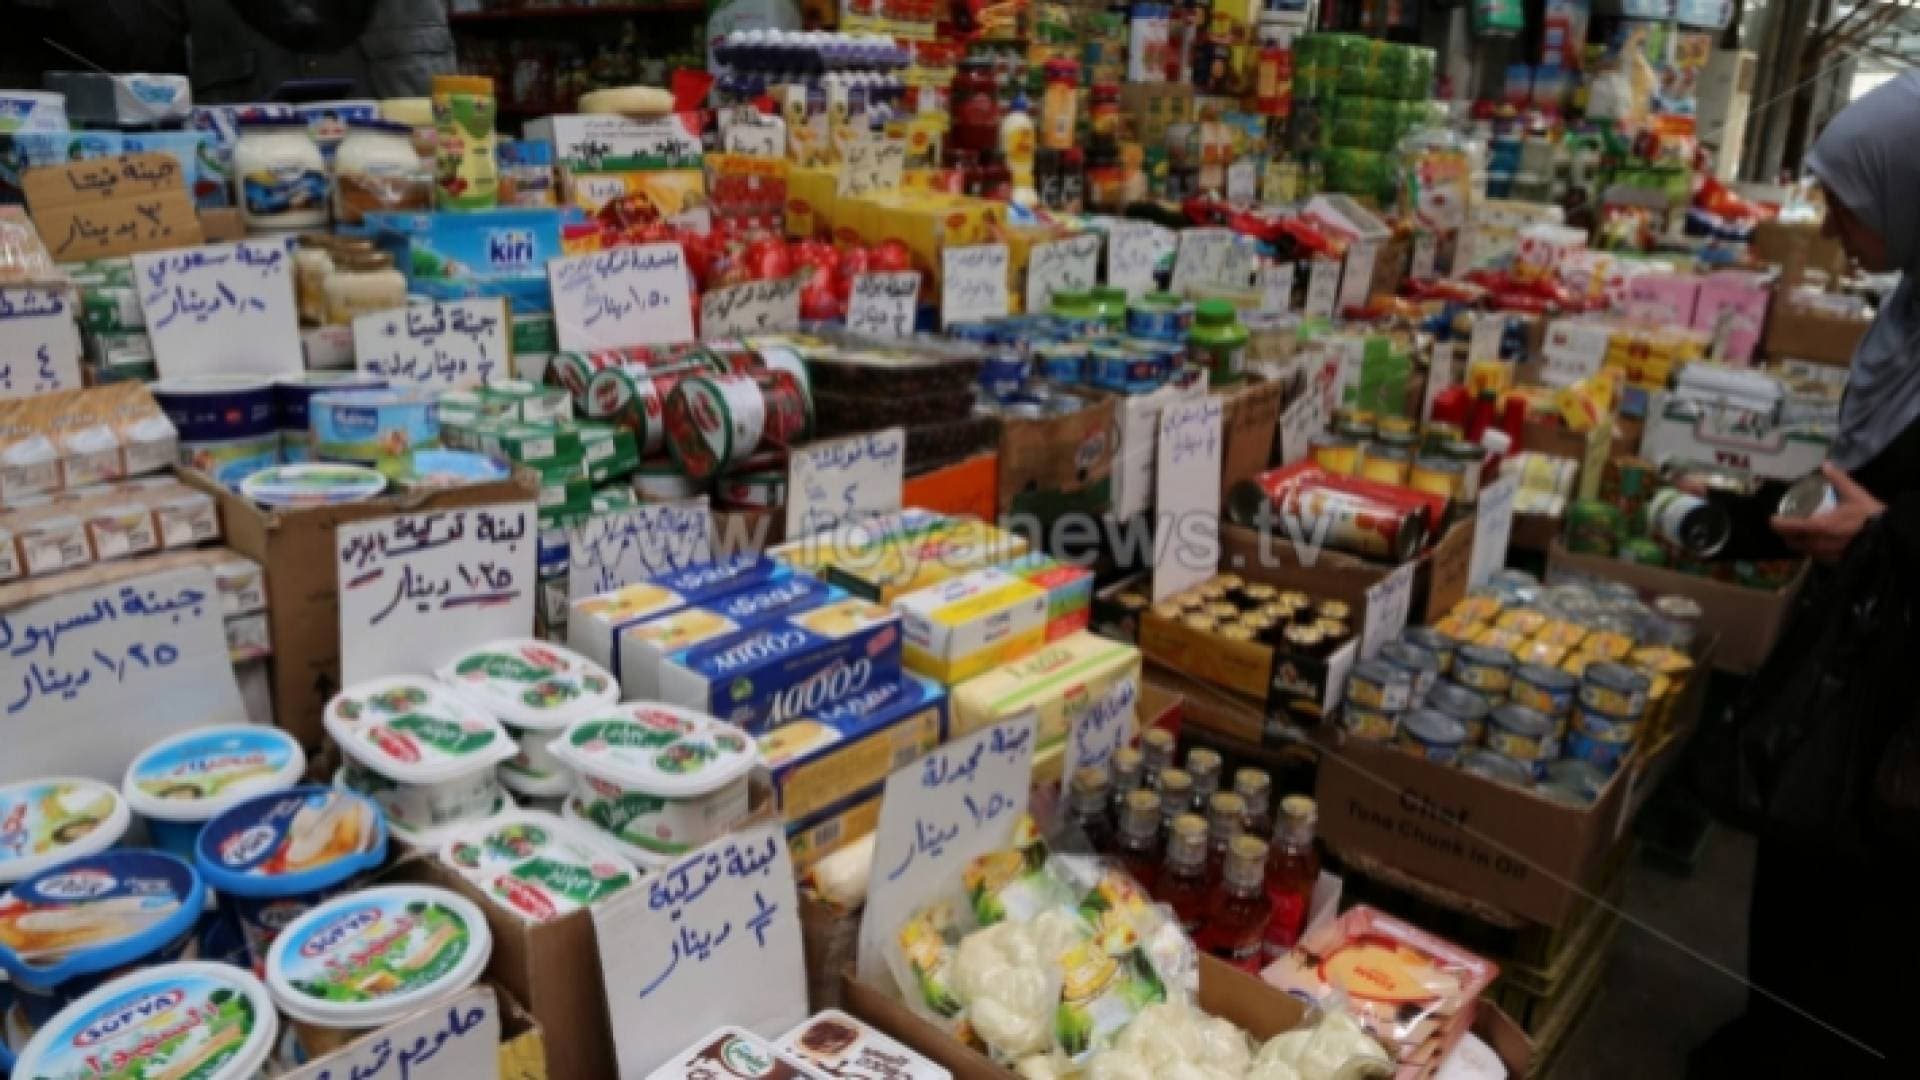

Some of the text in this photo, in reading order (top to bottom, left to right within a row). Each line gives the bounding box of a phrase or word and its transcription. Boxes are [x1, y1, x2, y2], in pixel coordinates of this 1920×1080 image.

[490, 234, 533, 264] kiri
[118, 585, 206, 626] جبنة
[369, 563, 452, 626] دينار
[7, 662, 92, 715] دينار
[1348, 799, 1395, 830] Tuna
[1400, 818, 1464, 856] Chunk
[1400, 786, 1469, 825] Chef
[726, 835, 779, 881] لبنة
[887, 817, 960, 881] دينار
[637, 920, 734, 1000] دينار
